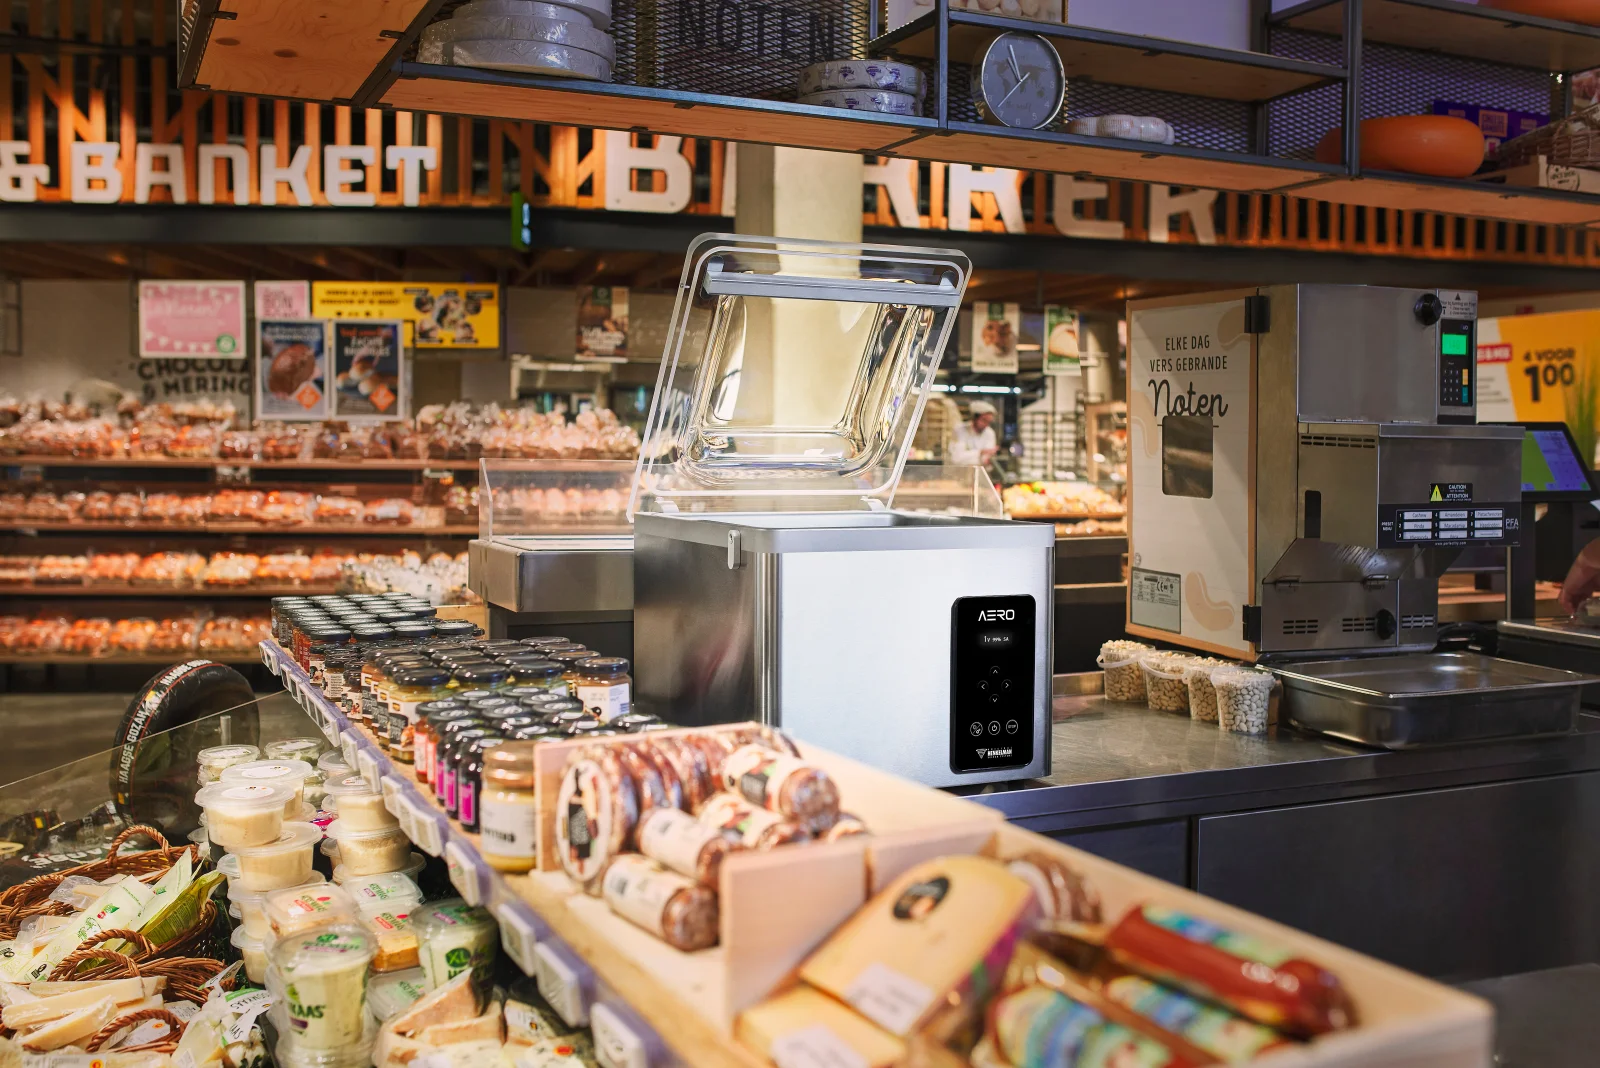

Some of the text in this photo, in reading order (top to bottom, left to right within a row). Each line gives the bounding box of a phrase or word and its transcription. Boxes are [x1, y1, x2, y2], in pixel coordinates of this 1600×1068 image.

[70, 141, 438, 207] BANKET
[1165, 334, 1210, 351] ELKE DAG
[1535, 347, 1576, 361] VOOR
[1149, 355, 1228, 373] VERS GEBRANDE
[1147, 378, 1229, 418] Noten
[1505, 518, 1519, 526] PFA
[977, 609, 1015, 622] AERO
[987, 748, 1013, 757] HENKELMAN
[118, 743, 135, 784] HAAGSE
[449, 950, 469, 966] XL
